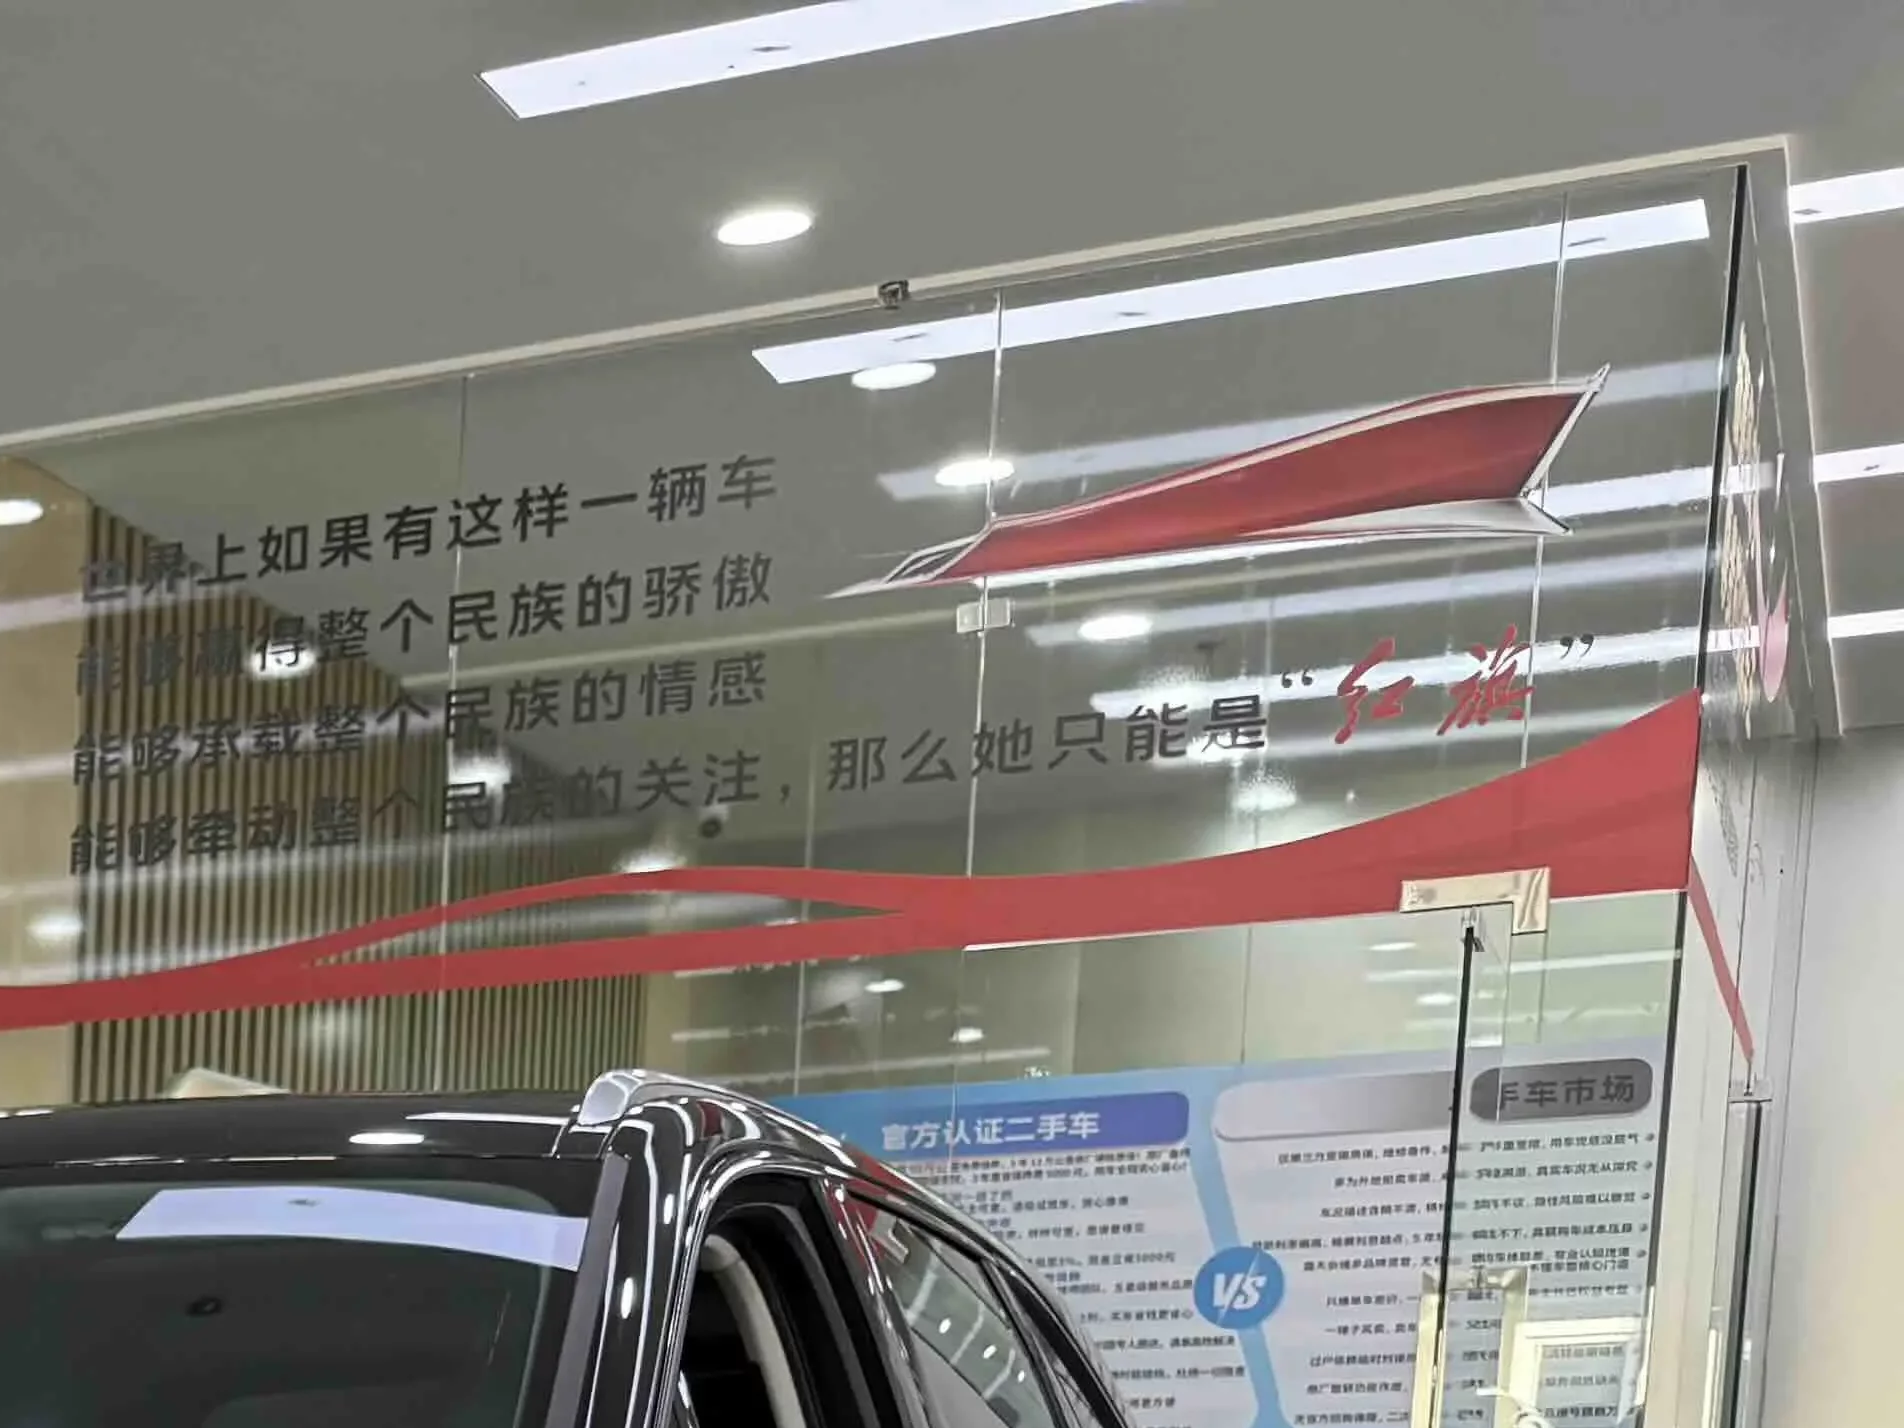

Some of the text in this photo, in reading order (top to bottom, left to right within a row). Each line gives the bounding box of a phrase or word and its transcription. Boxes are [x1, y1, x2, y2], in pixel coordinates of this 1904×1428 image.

[81, 452, 778, 604] 世界上如果有这样一辆车
[73, 650, 768, 786] 能够承载整个民族的情感
[882, 1111, 1101, 1151] 官方认证二手车
[1212, 1273, 1267, 1313] VS
